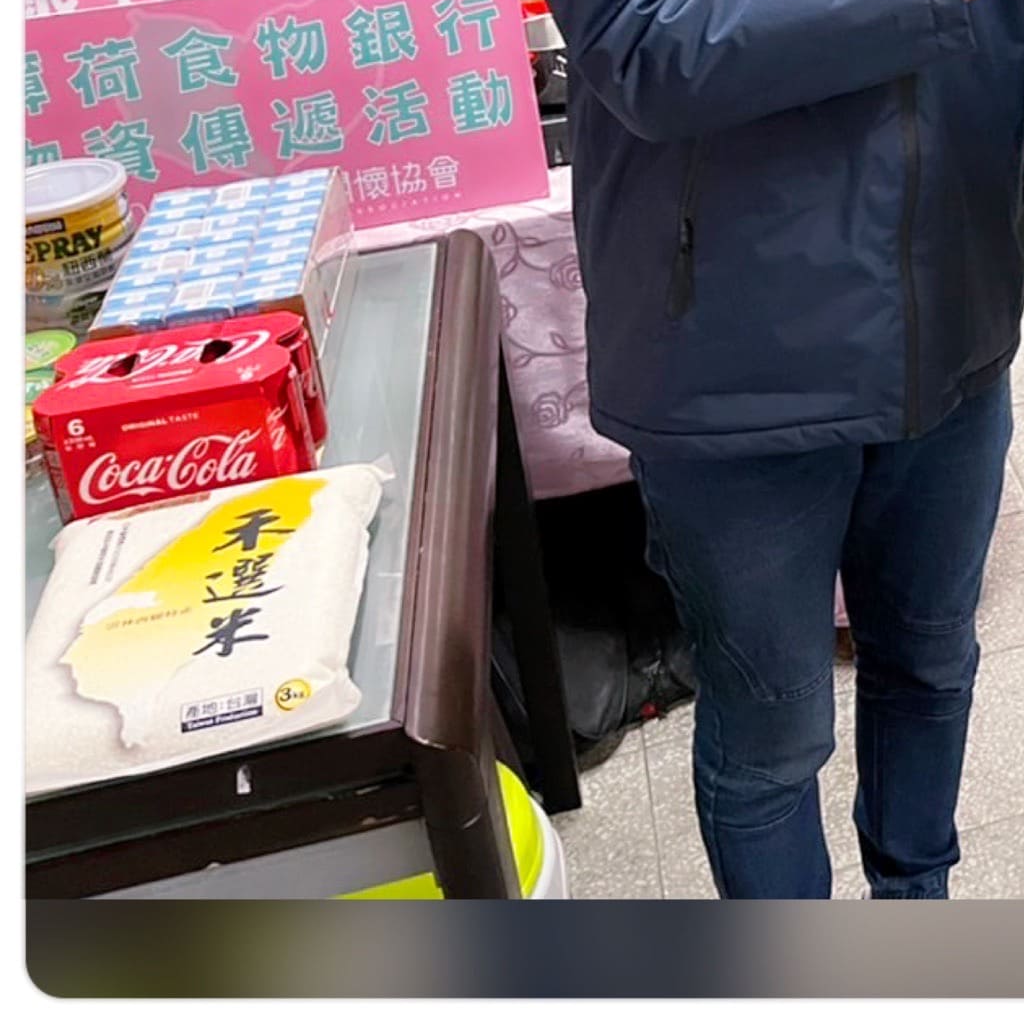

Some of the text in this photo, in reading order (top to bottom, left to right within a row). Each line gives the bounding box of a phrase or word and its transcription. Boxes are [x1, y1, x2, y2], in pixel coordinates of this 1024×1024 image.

[341, 155, 459, 204] 懷協會
[67, 418, 86, 437] 6
[78, 428, 262, 505] Coca-Cola
